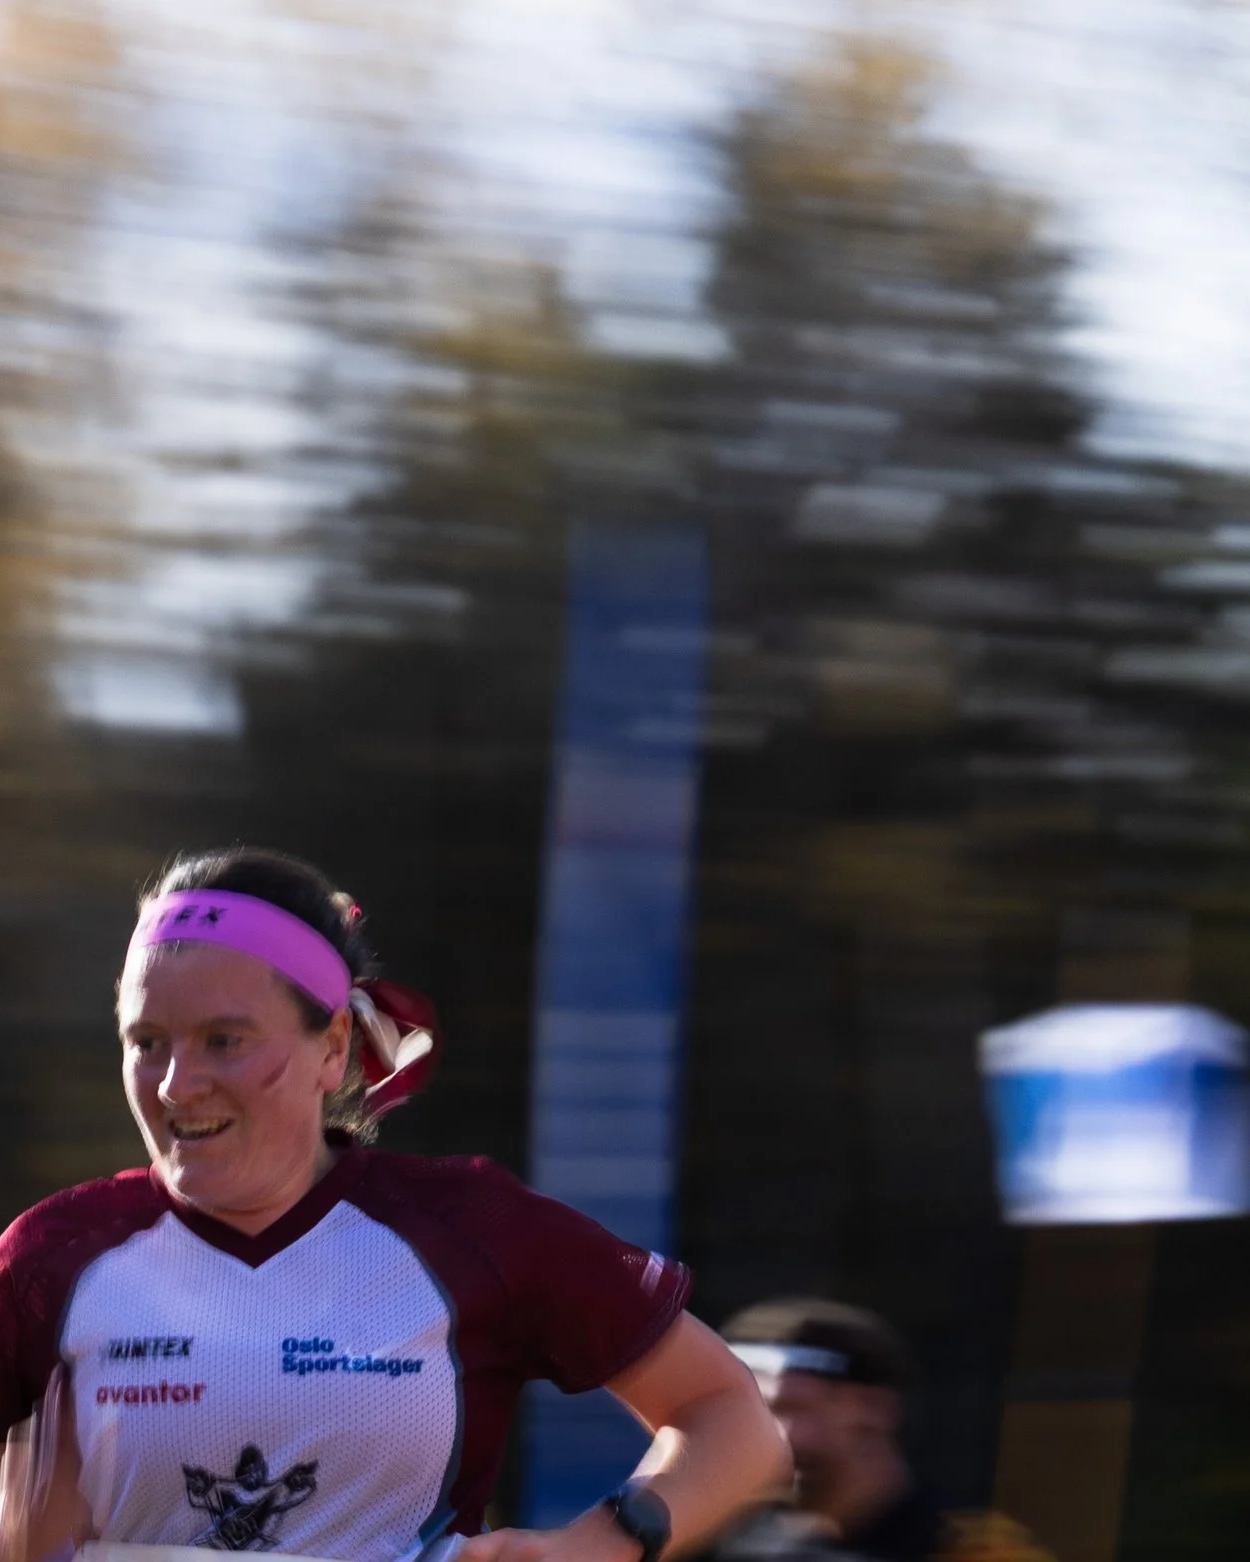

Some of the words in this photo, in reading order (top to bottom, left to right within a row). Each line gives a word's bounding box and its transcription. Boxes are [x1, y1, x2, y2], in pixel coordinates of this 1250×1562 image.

[282, 1337, 334, 1353] Oslo
[282, 1353, 424, 1376] Sportslager
[96, 1380, 206, 1405] avantor
